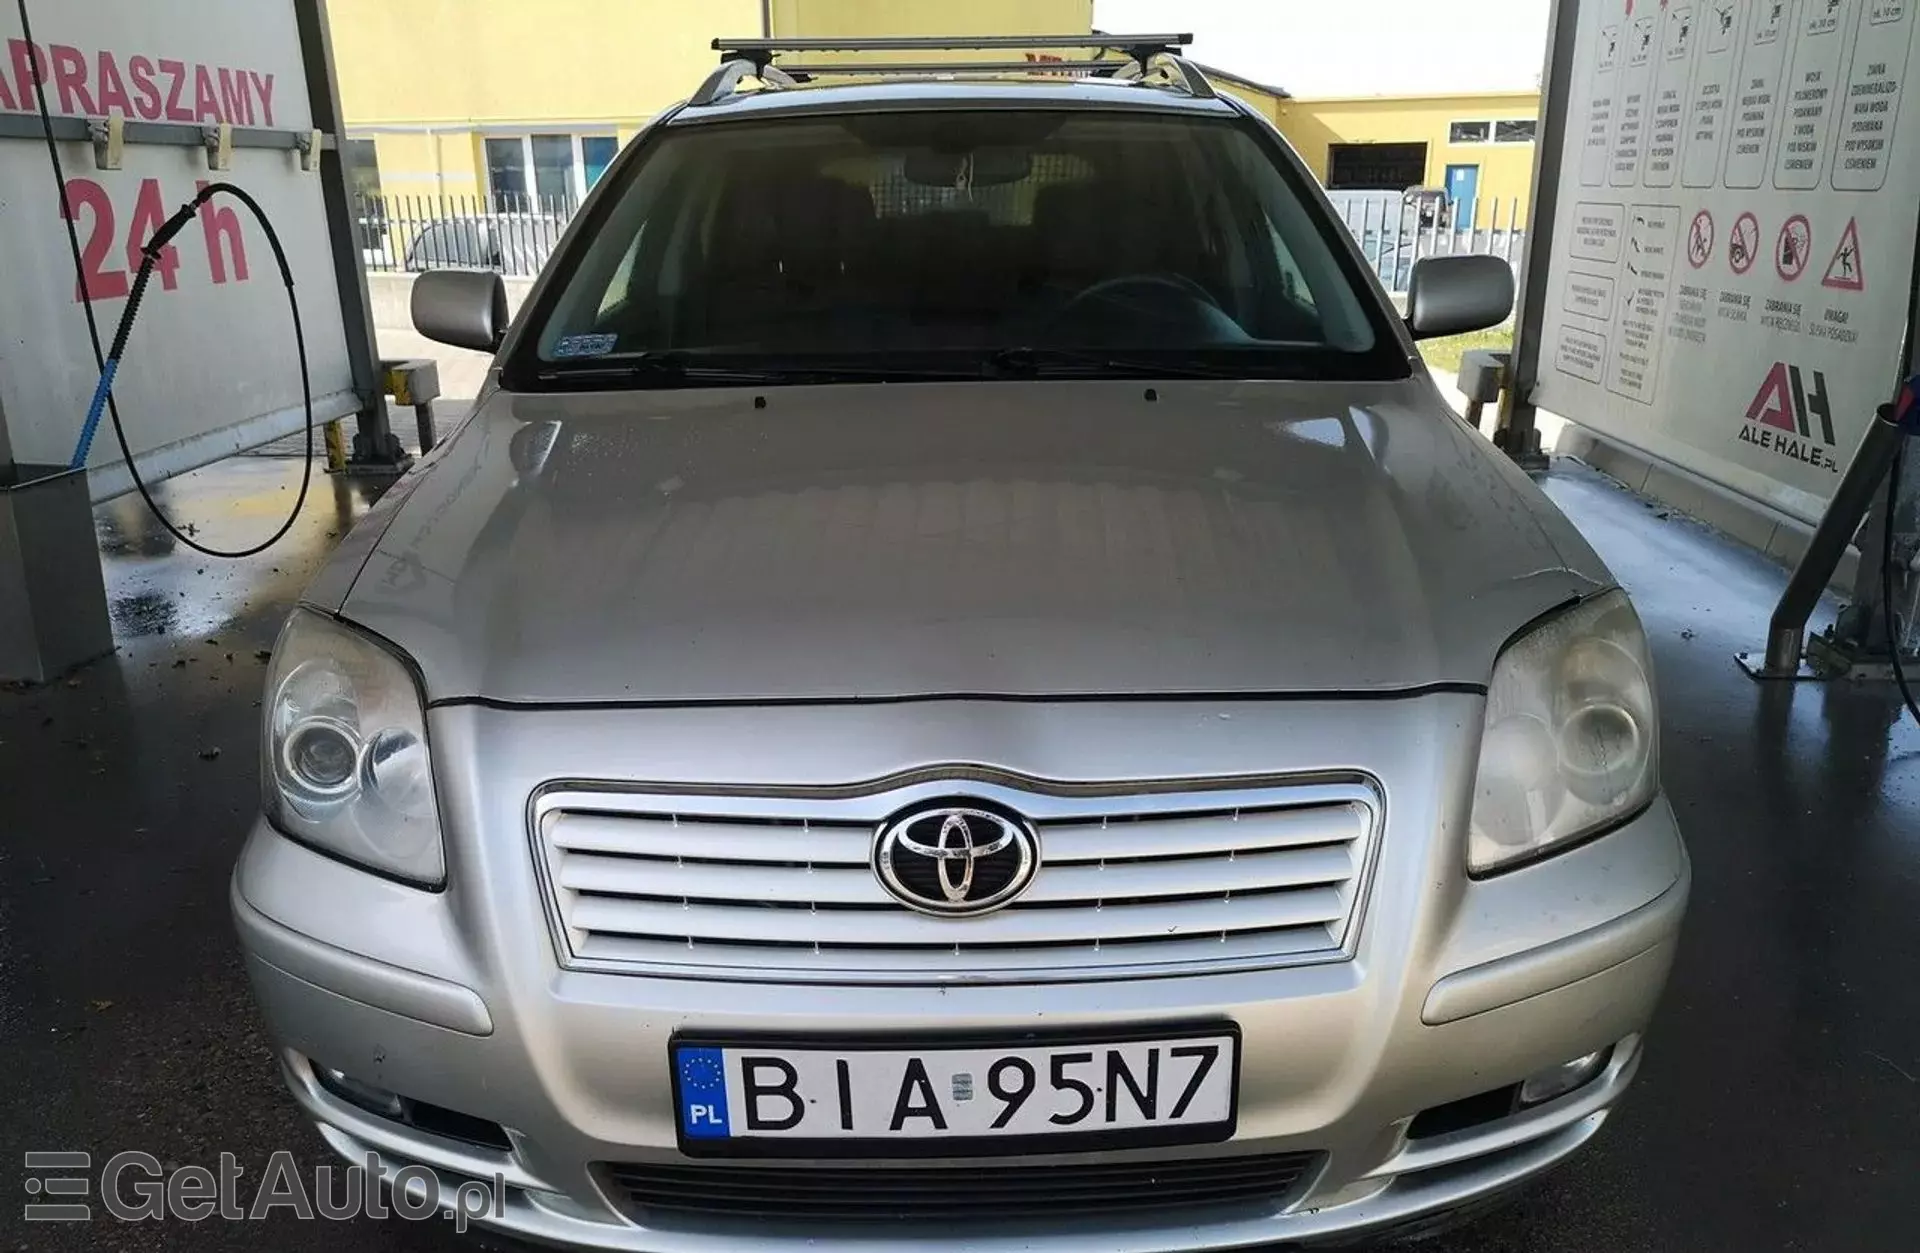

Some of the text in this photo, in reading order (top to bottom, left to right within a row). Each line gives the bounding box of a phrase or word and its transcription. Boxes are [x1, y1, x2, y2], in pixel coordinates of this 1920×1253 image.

[59, 178, 249, 303] 24 h
[1738, 424, 1838, 473] ALE HALE.PL
[690, 1104, 722, 1124] PL
[740, 1045, 1220, 1131] BIA 95N7
